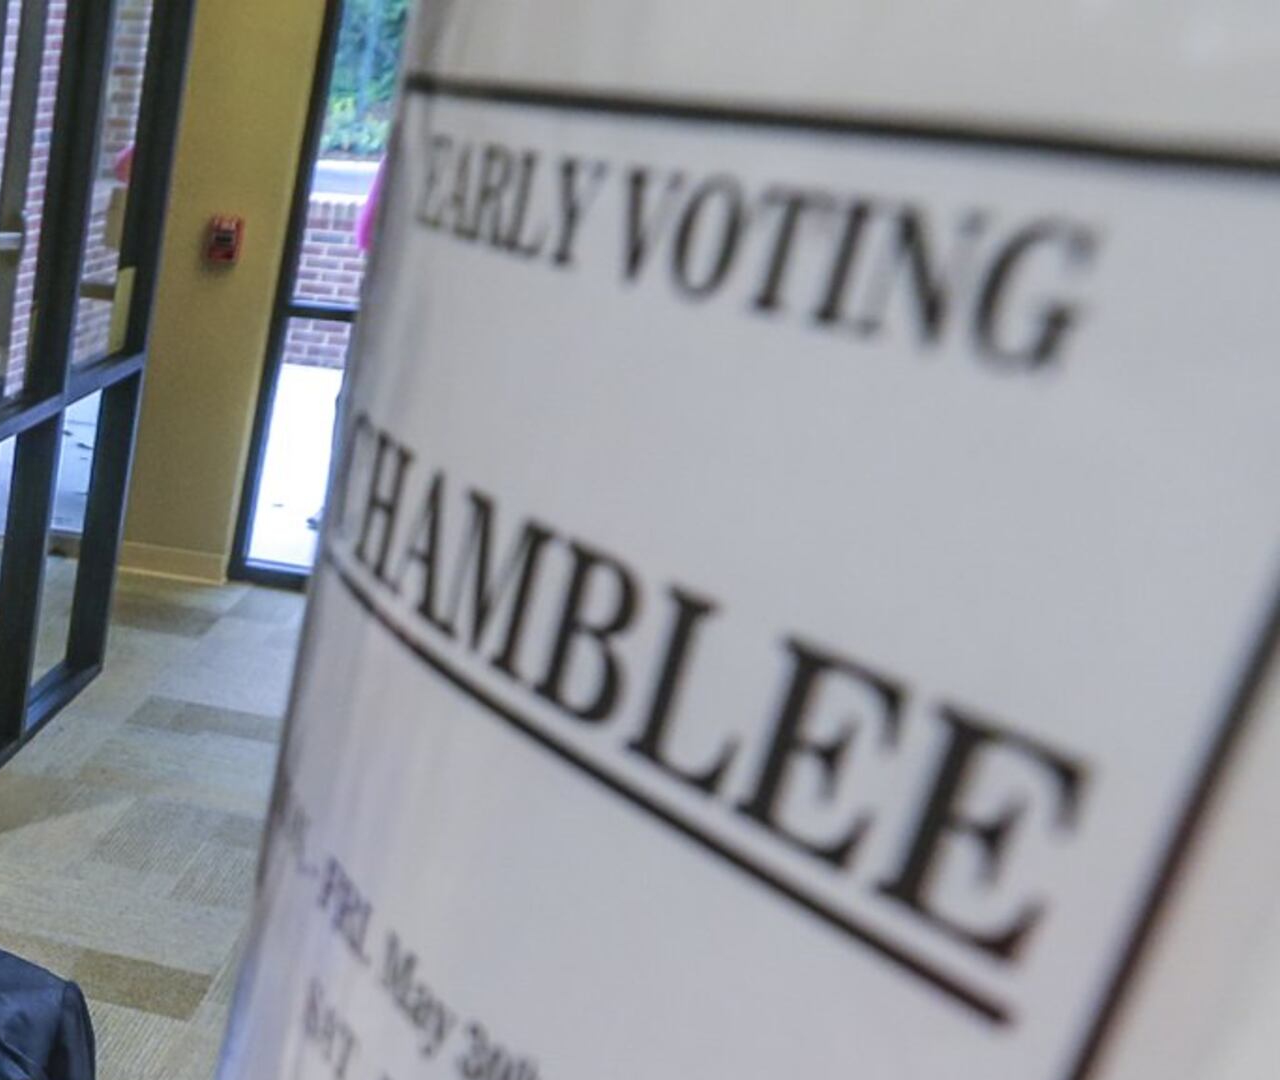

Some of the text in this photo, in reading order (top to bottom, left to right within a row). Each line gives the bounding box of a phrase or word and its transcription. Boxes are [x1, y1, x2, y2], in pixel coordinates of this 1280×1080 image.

[414, 132, 1100, 375] EARLY VOTING
[332, 408, 1095, 968] CHAMBLEE
[380, 928, 460, 1060] May
